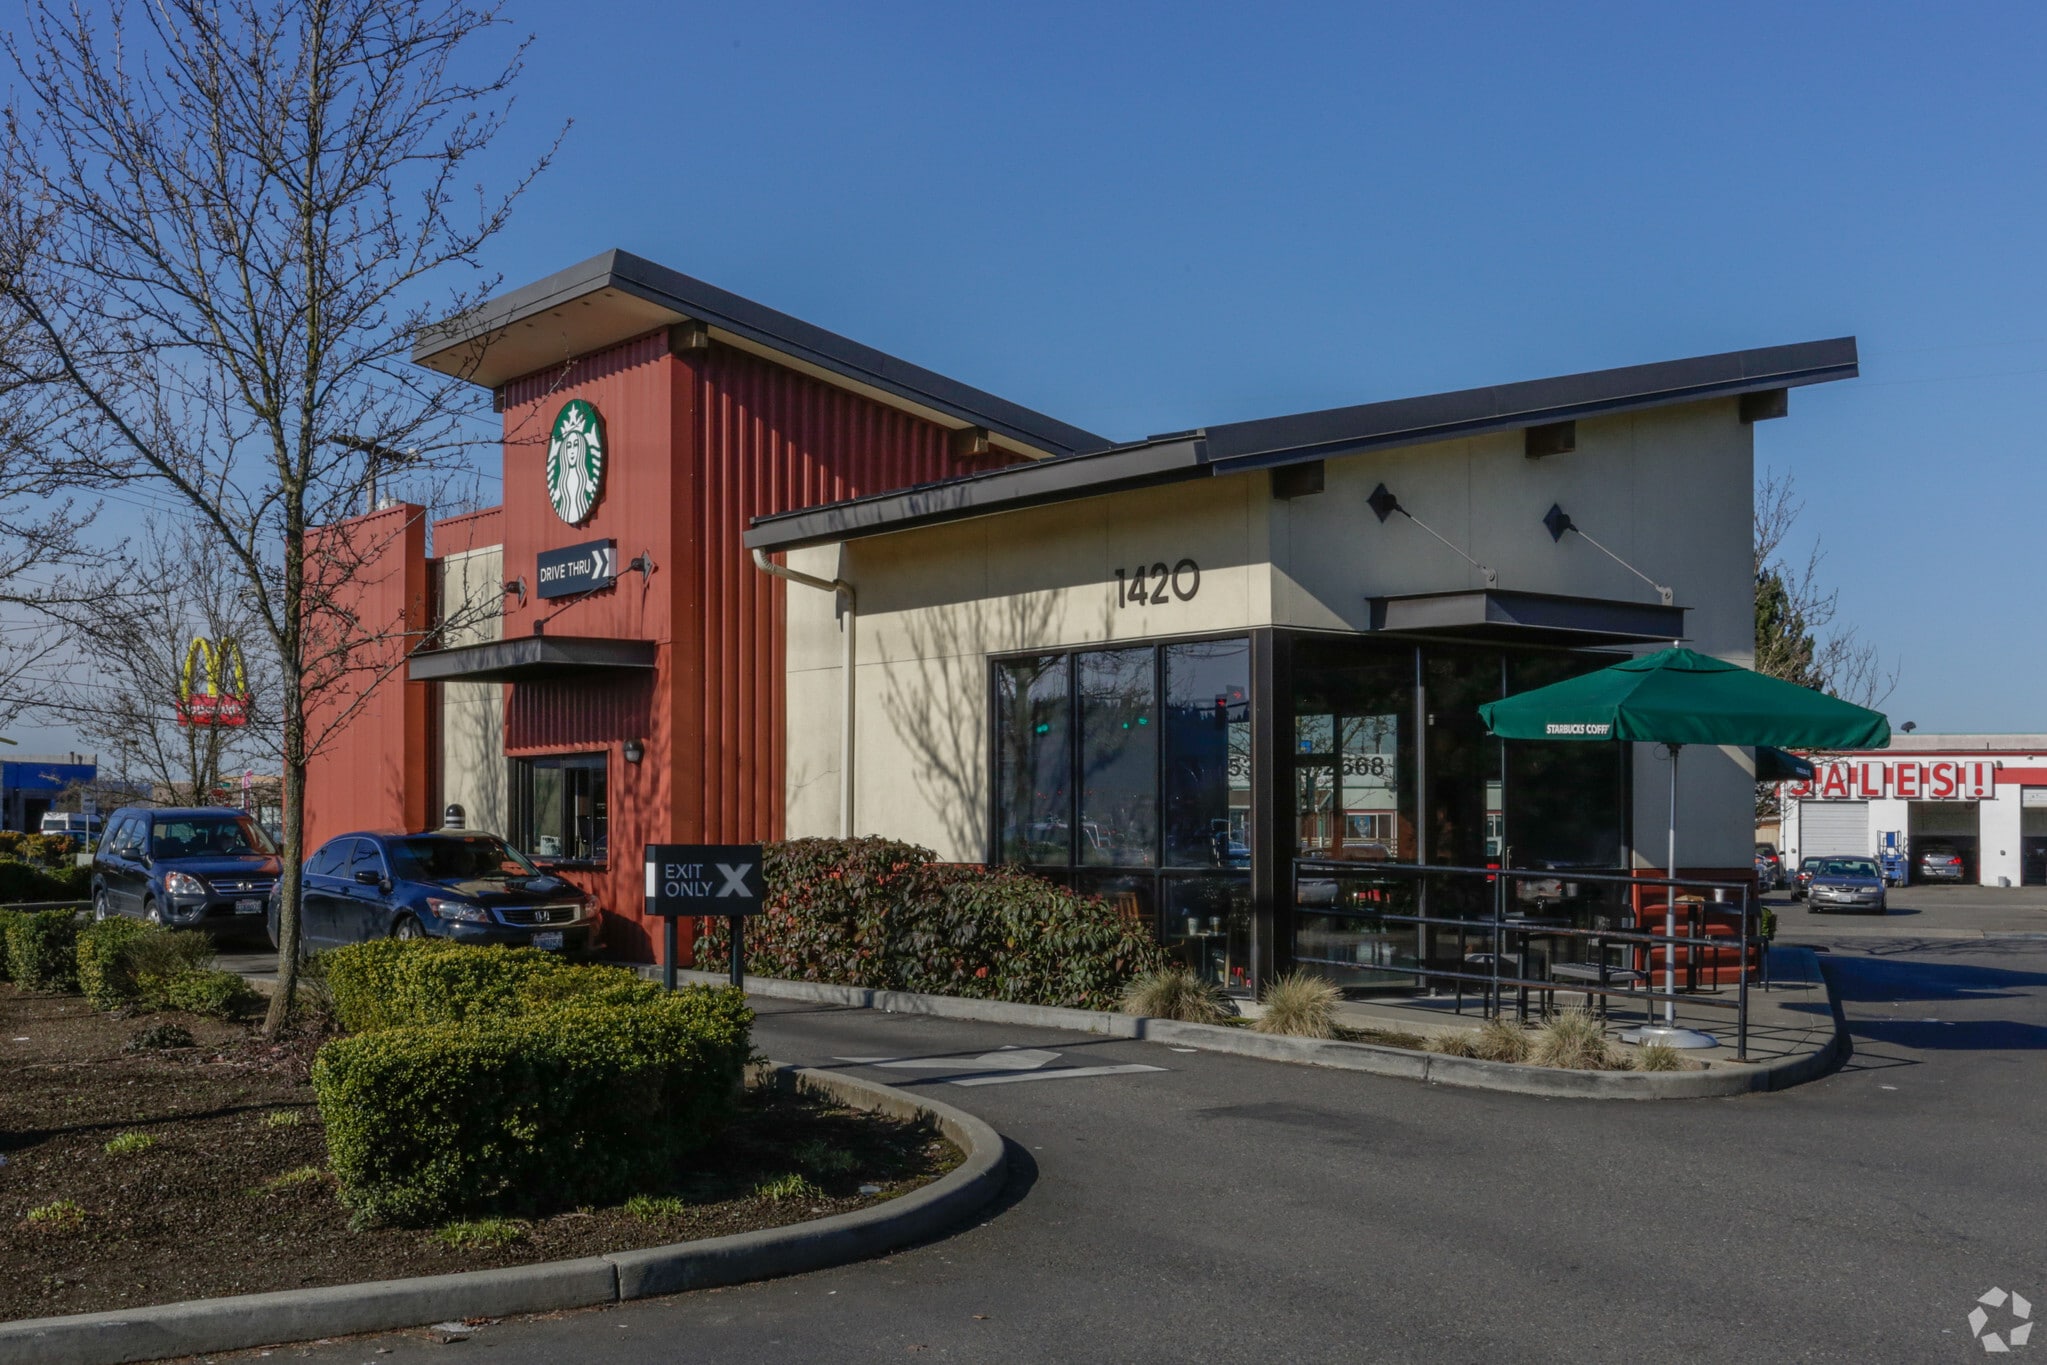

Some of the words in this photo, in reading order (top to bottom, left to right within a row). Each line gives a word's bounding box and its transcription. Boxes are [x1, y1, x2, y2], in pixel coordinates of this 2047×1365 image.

[540, 563, 566, 583] DRIVE
[567, 558, 591, 577] THRU
[1114, 558, 1200, 609] 1420
[1546, 723, 1585, 735] STARBUCKS
[664, 863, 704, 879] EXIT
[664, 881, 713, 897] ONLY
